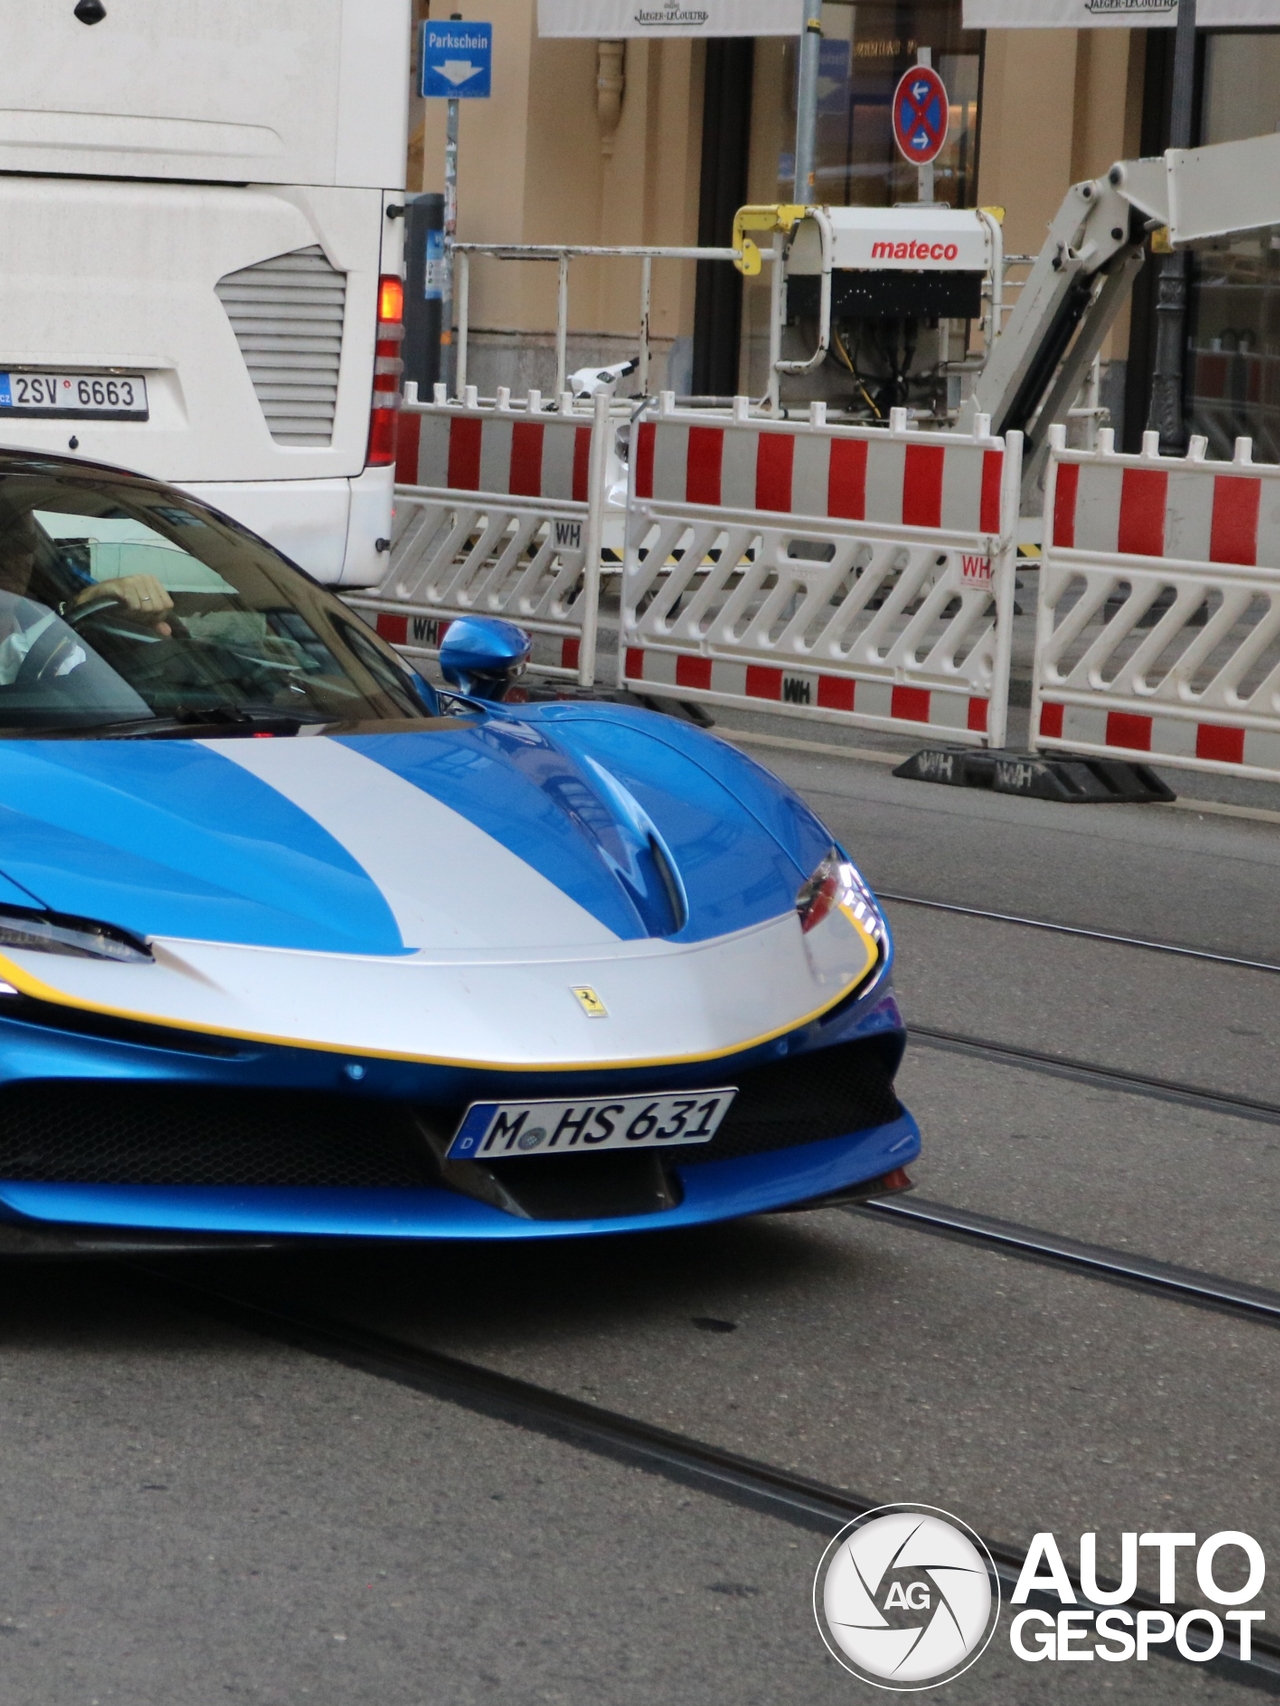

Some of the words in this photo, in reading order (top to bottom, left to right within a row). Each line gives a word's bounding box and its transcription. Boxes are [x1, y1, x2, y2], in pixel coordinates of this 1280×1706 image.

[429, 32, 488, 49] Parkschein
[871, 239, 958, 261] mateco
[0, 394, 11, 403] CZ
[16, 378, 57, 404] 2SV
[77, 379, 134, 406] 6663
[556, 522, 581, 548] WH
[962, 555, 991, 579] WH
[413, 617, 438, 645] WH
[784, 677, 810, 704] WH
[483, 1110, 530, 1151] M
[548, 1104, 625, 1147] HS
[625, 1098, 721, 1141] 631
[460, 1137, 473, 1149] D
